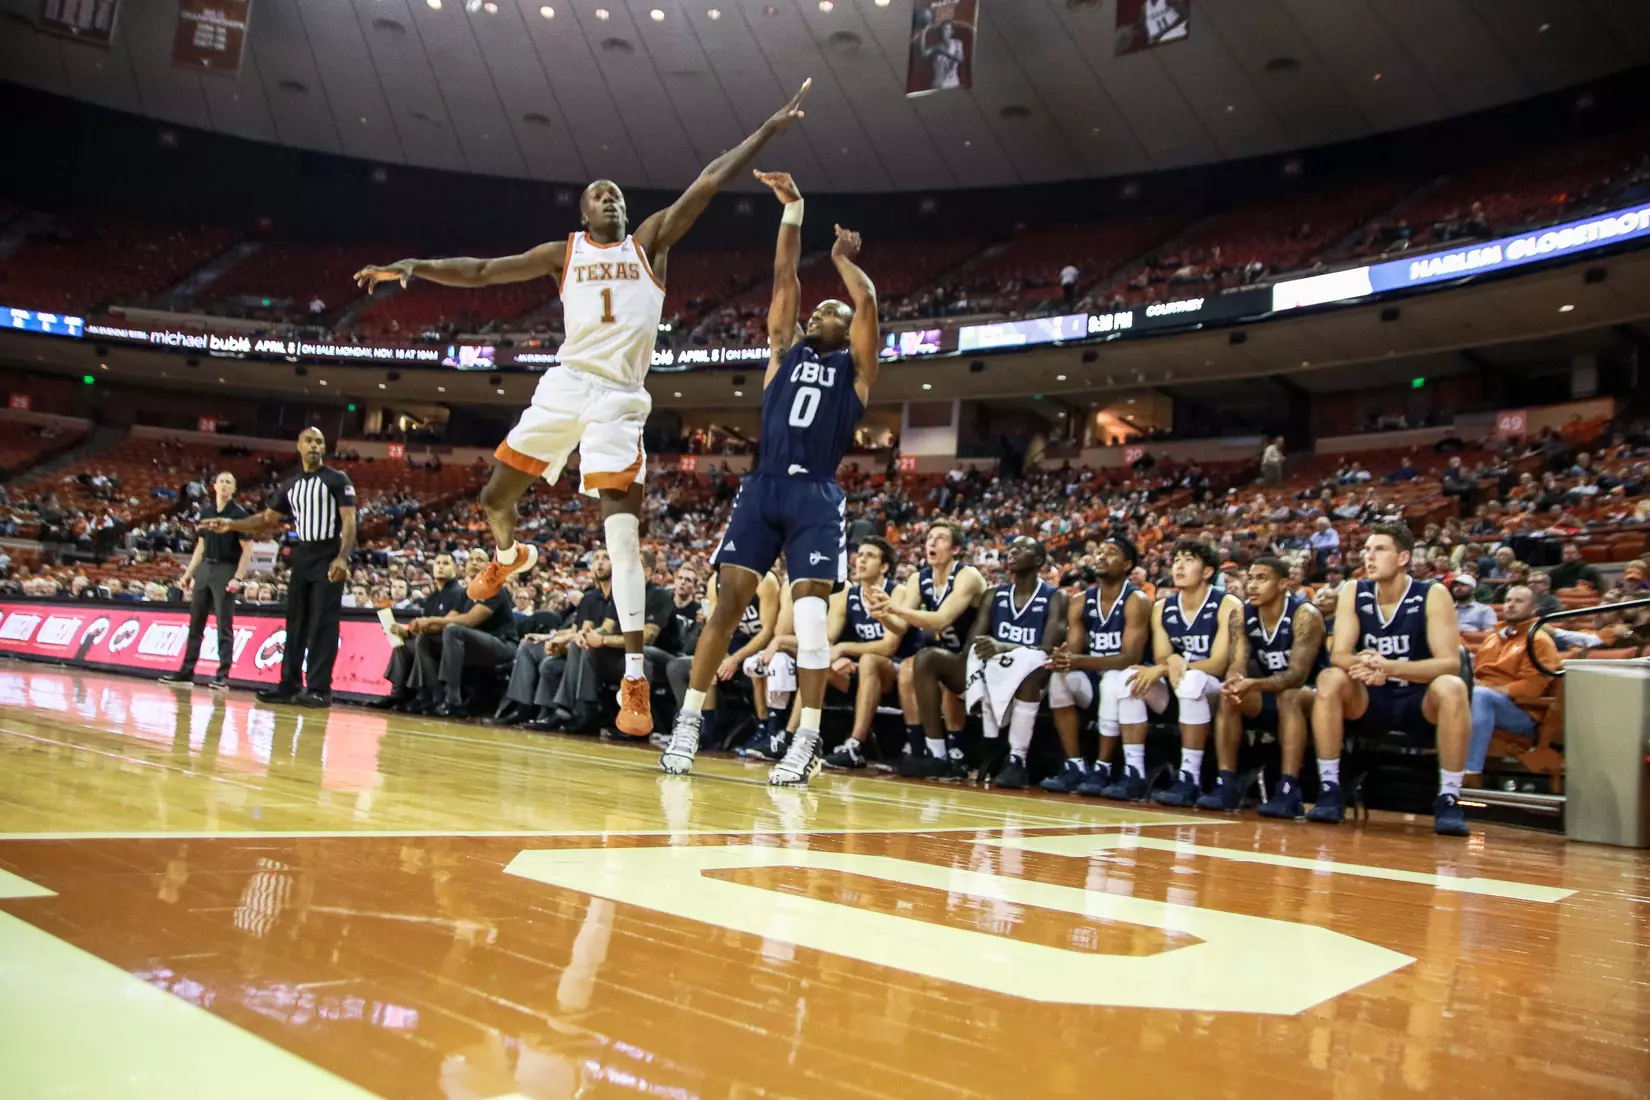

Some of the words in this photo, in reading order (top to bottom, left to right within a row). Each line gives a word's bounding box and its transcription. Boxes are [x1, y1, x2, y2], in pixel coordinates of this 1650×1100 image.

[574, 261, 640, 283] TEXAS
[1410, 245, 1502, 280] HARLEM
[600, 288, 616, 323] 1
[150, 330, 207, 348] michael
[255, 339, 286, 354] APRIL
[302, 344, 315, 355] ON
[316, 345, 335, 356] SALE
[404, 349, 416, 360] AT
[678, 350, 710, 364] APRIL
[726, 349, 741, 361] ON
[741, 348, 761, 360] SALE
[790, 361, 836, 387] CBU
[788, 386, 822, 428] 0
[1500, 416, 1522, 430] 49
[998, 621, 1036, 645] CBU
[1170, 635, 1209, 653] CBU
[1364, 633, 1410, 656] CBU
